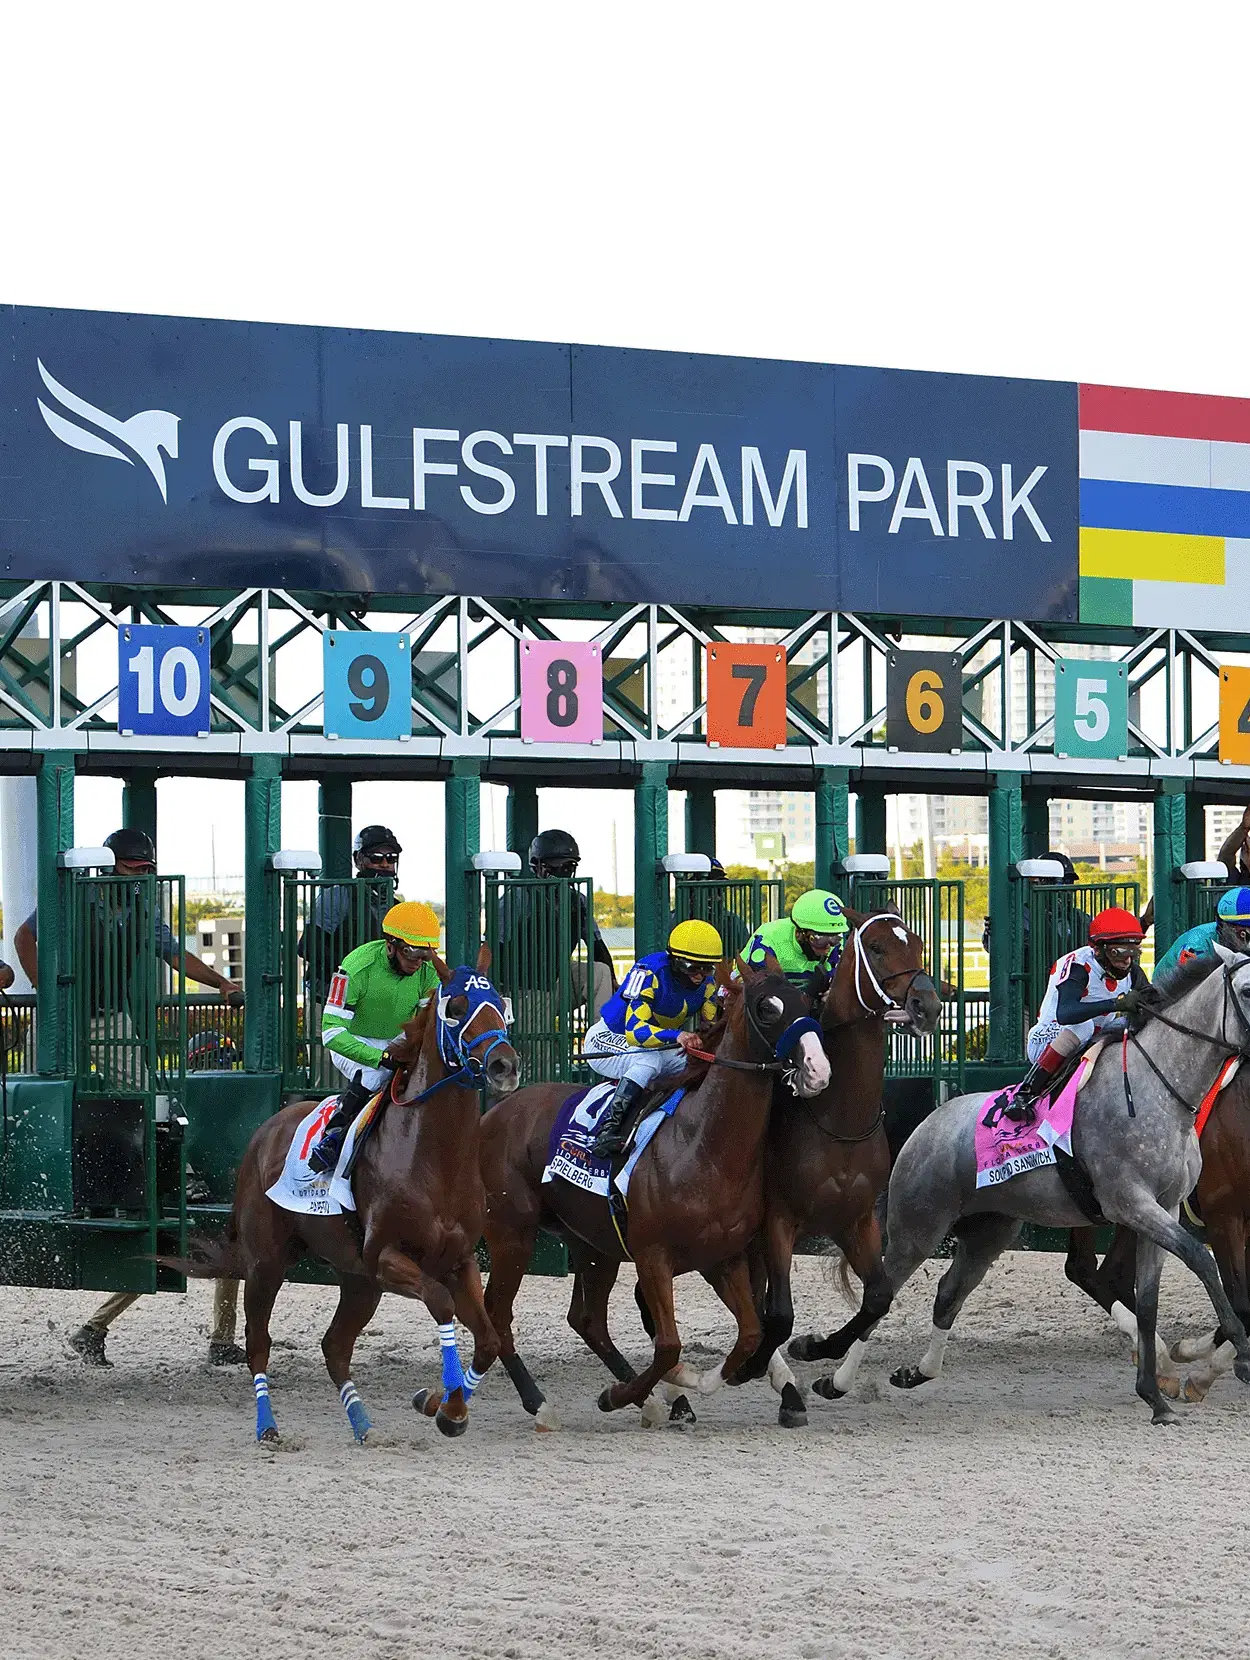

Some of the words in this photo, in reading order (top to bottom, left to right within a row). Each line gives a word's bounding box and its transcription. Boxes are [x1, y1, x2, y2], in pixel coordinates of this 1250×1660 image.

[212, 416, 809, 529] GULFSTREAM
[847, 453, 1052, 543] PARK
[128, 646, 201, 717] 10
[346, 654, 390, 722] 9
[546, 659, 579, 727] 8
[731, 665, 767, 727] 7
[906, 670, 945, 733] 6
[1073, 679, 1111, 742] 5
[328, 976, 348, 1007] 11
[464, 975, 491, 992] AS
[623, 970, 647, 999] 10
[550, 1158, 593, 1189] SPIELBERG
